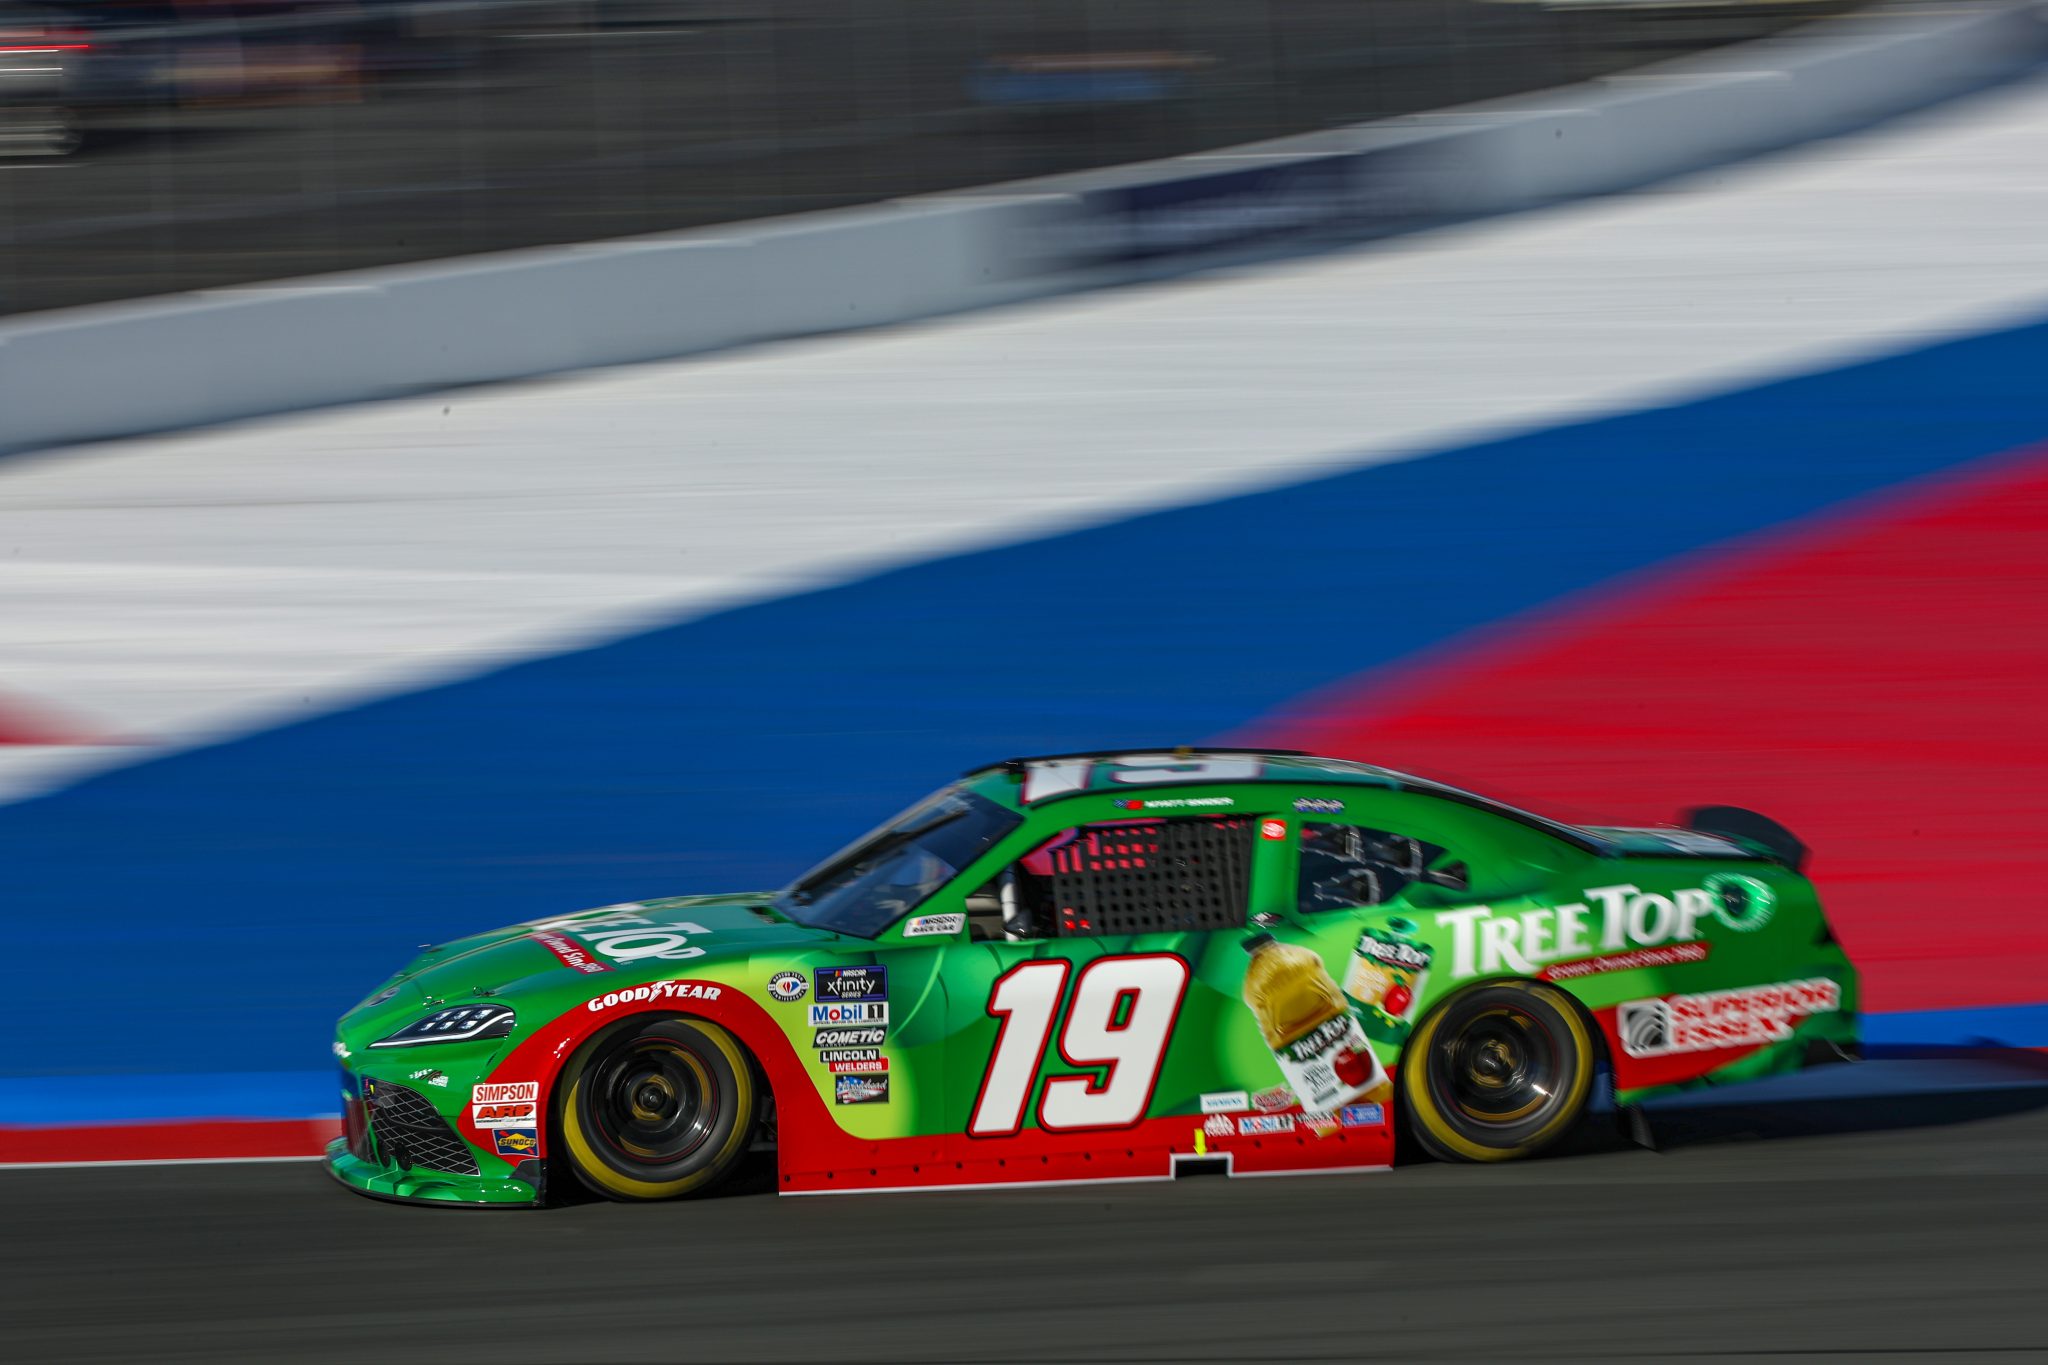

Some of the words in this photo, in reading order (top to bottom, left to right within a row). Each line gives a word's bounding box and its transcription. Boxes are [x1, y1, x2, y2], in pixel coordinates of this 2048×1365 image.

[1434, 903, 1592, 978] TREE
[1583, 884, 1716, 950] TOP
[842, 969, 867, 978] NASCAR
[827, 977, 876, 996] xfinity
[587, 982, 722, 1012] GOODYEAR
[841, 991, 862, 999] SERIES
[813, 1004, 863, 1021] Mobil
[816, 1030, 885, 1045] COMETIC
[969, 954, 1189, 1137] 19
[822, 1049, 877, 1062] LINCOLN
[834, 1061, 883, 1072] WELDERS
[476, 1084, 535, 1102] SIMPSON
[476, 1104, 534, 1119] ARP
[499, 1138, 537, 1146] SUNOCO
